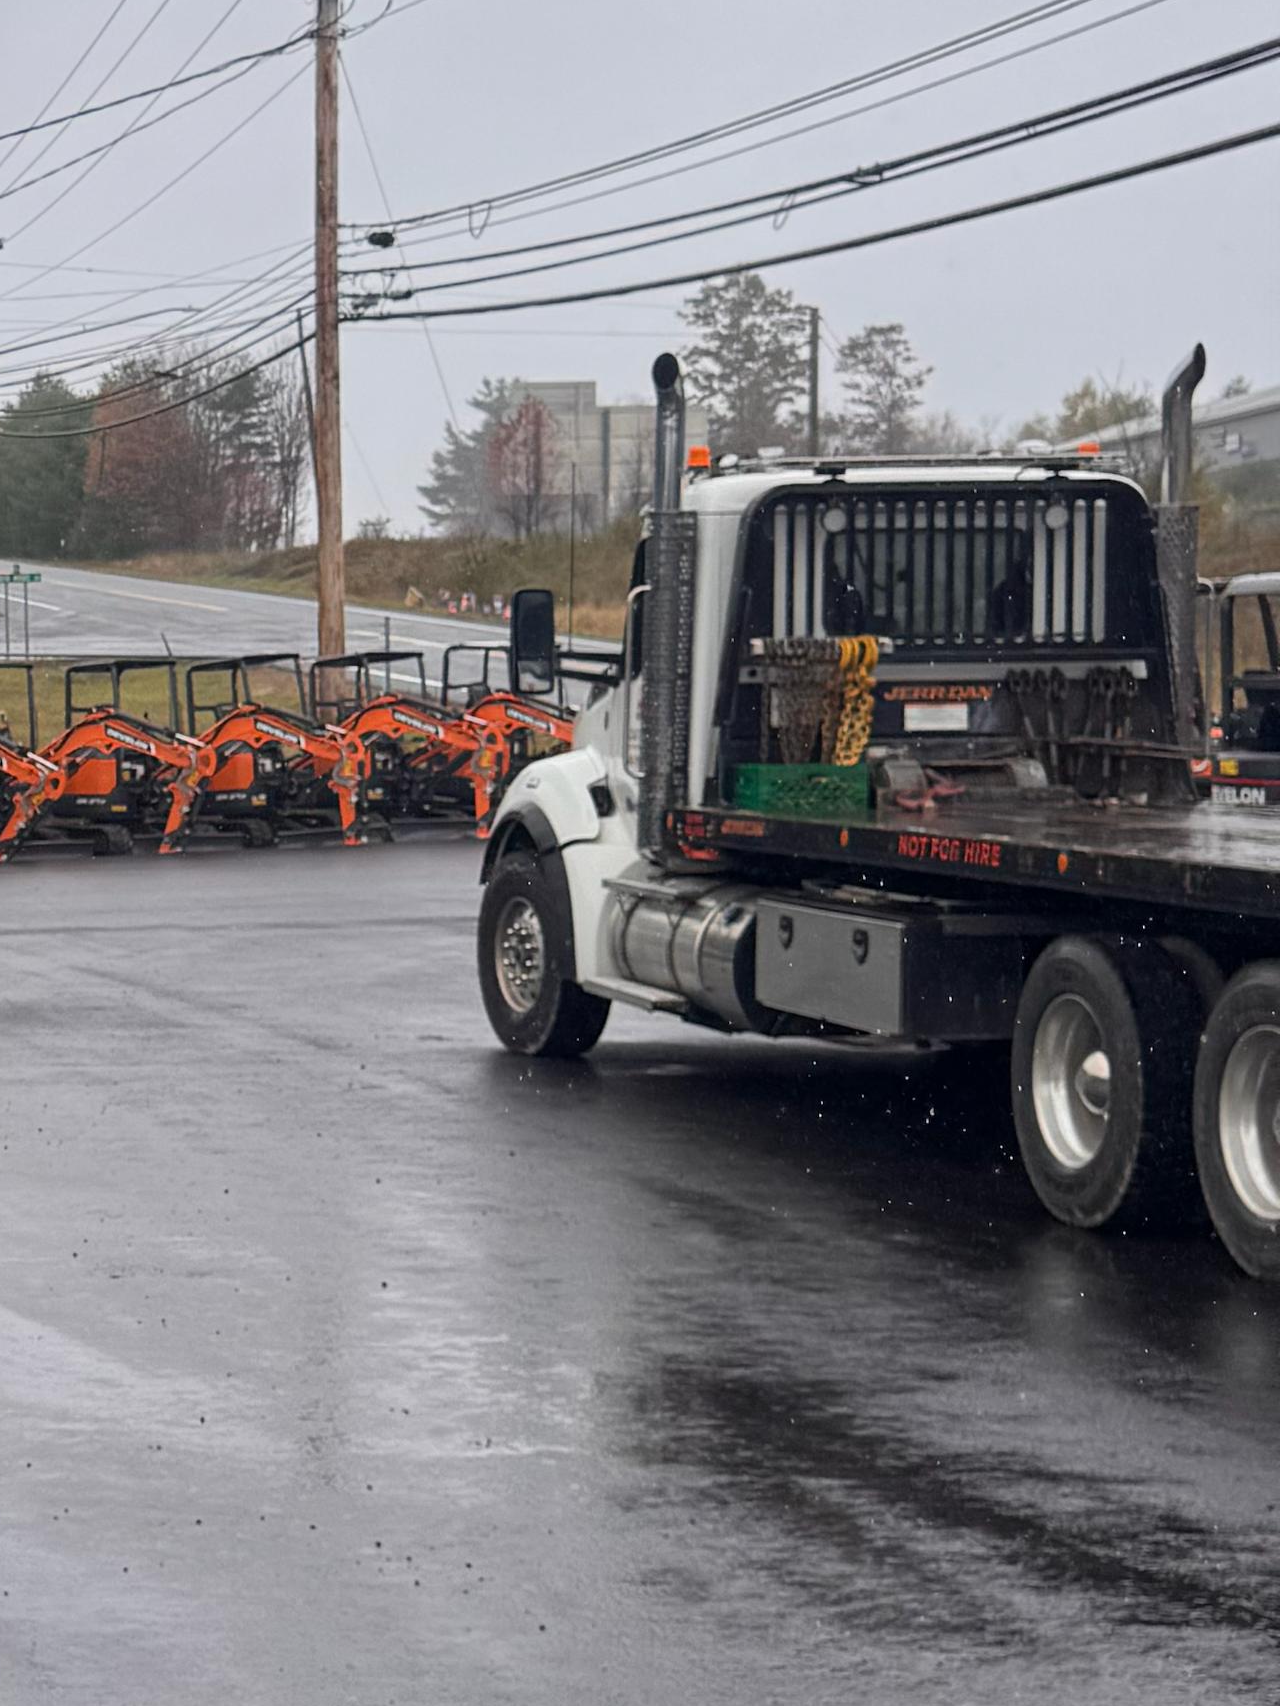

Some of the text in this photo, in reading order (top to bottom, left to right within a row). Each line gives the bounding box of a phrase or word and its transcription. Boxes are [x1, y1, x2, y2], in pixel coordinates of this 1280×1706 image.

[897, 835, 1001, 868] NOT FOR HIRE
